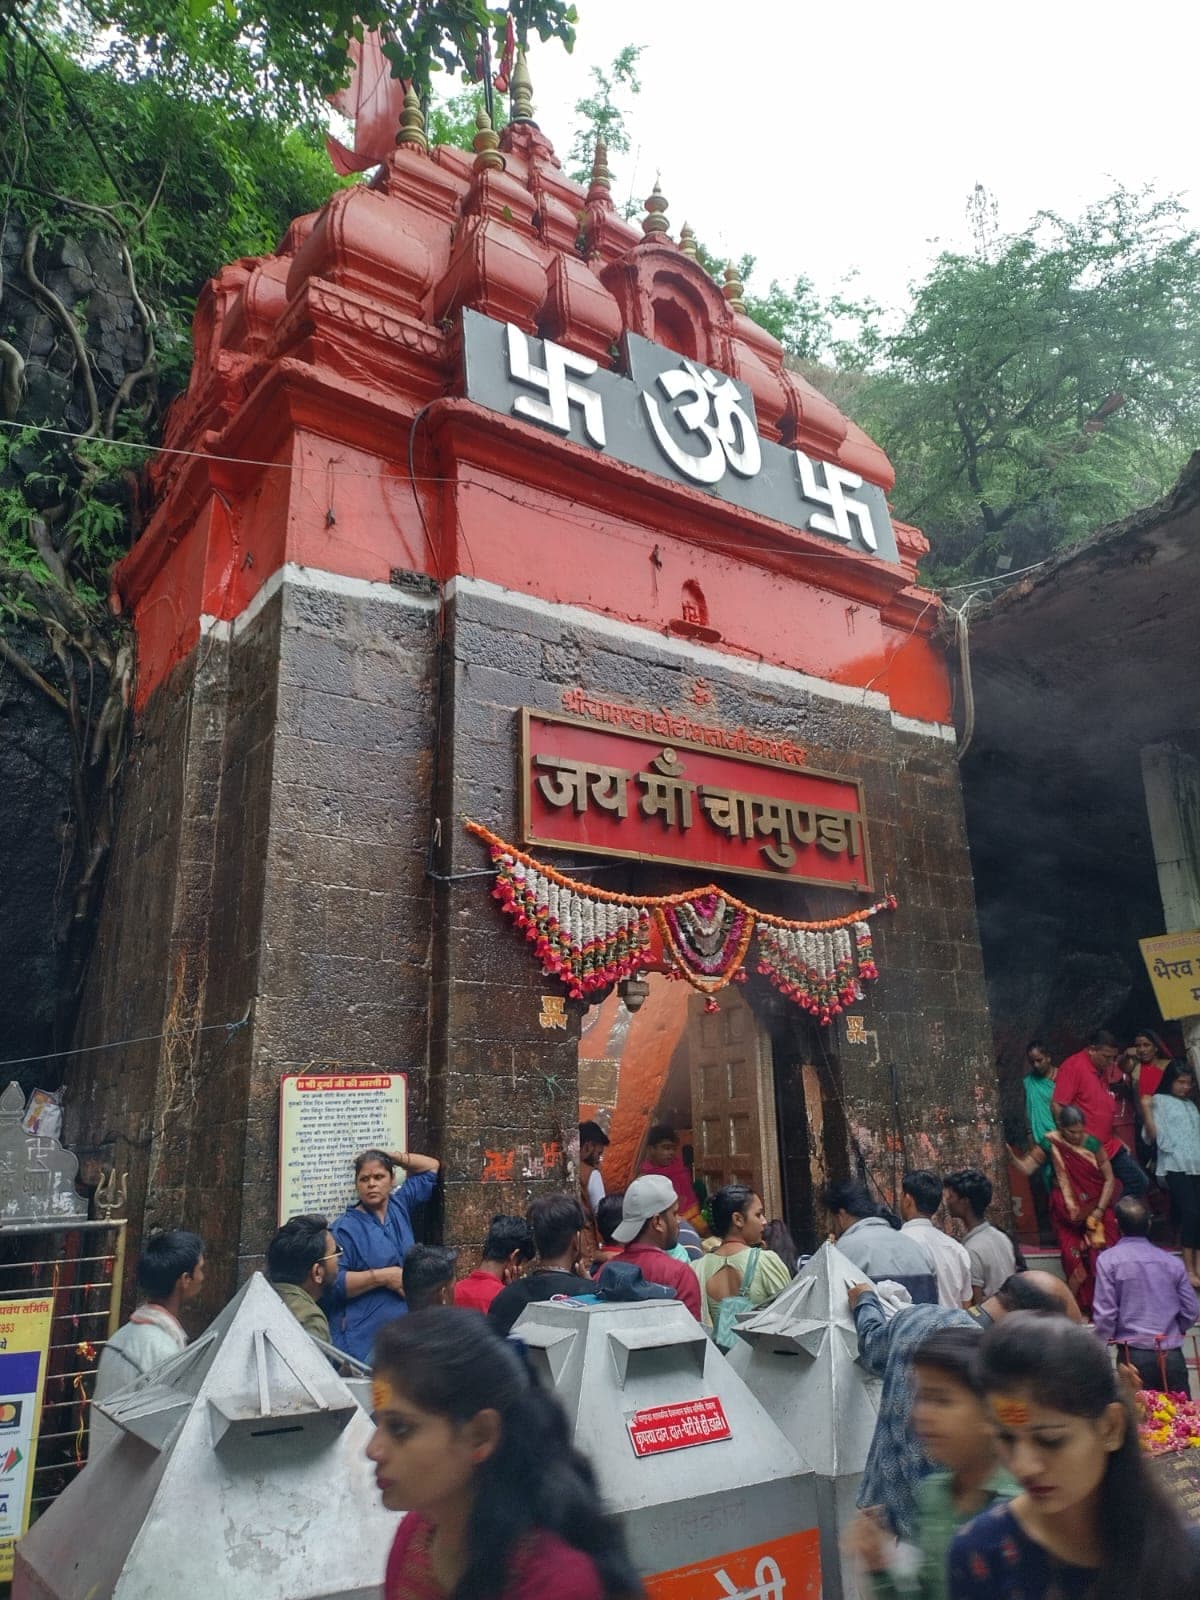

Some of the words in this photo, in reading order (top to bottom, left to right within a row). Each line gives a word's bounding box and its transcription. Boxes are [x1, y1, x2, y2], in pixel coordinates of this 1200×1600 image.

[533, 754, 630, 818] जय
[635, 747, 697, 831] माँ
[698, 783, 862, 869] चामुण्डा
[1153, 958, 1193, 980] भैरव
[634, 1429, 658, 1451] कृपया
